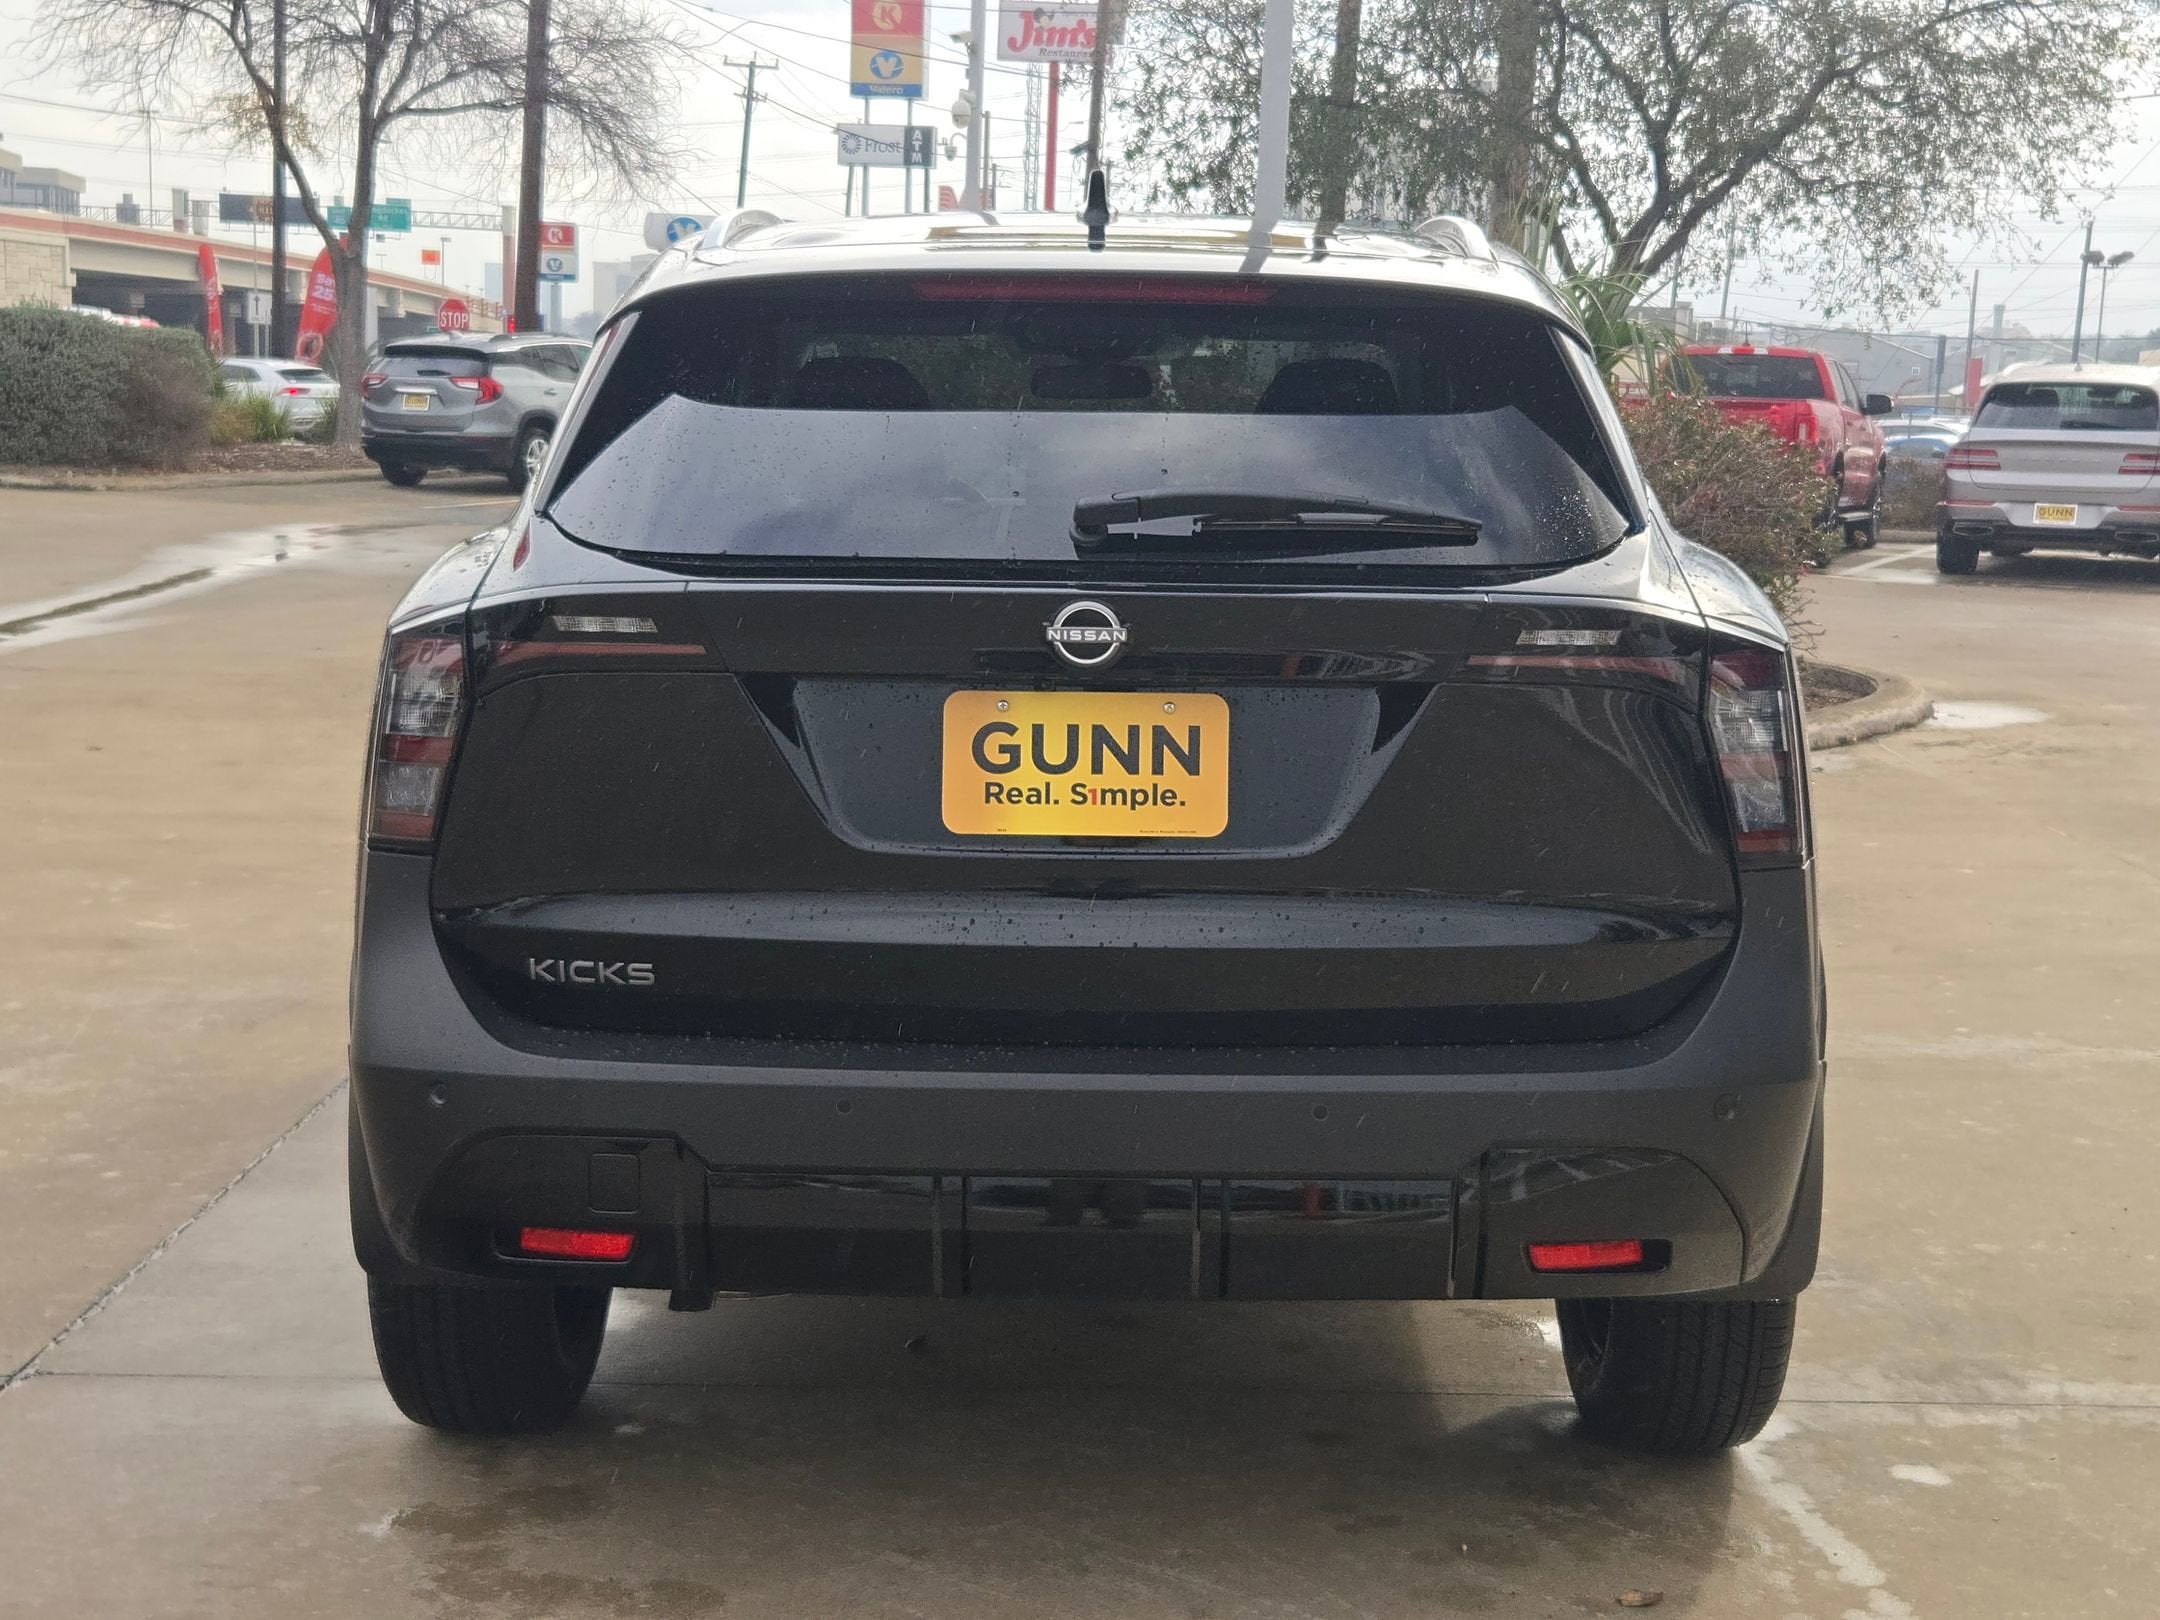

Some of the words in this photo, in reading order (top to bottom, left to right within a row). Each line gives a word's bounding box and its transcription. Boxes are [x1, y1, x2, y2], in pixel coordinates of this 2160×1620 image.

[1007, 10, 1096, 52] Jim's
[865, 138, 902, 153] Frost
[911, 130, 923, 163] ATM
[440, 311, 469, 329] STOP
[2039, 507, 2073, 517] GUNN
[1048, 629, 1126, 641] NISSAN
[971, 721, 1201, 776] GUNN
[984, 782, 1060, 806] Real.
[1070, 782, 1186, 811] S1mple.
[529, 957, 655, 985] KICKS
